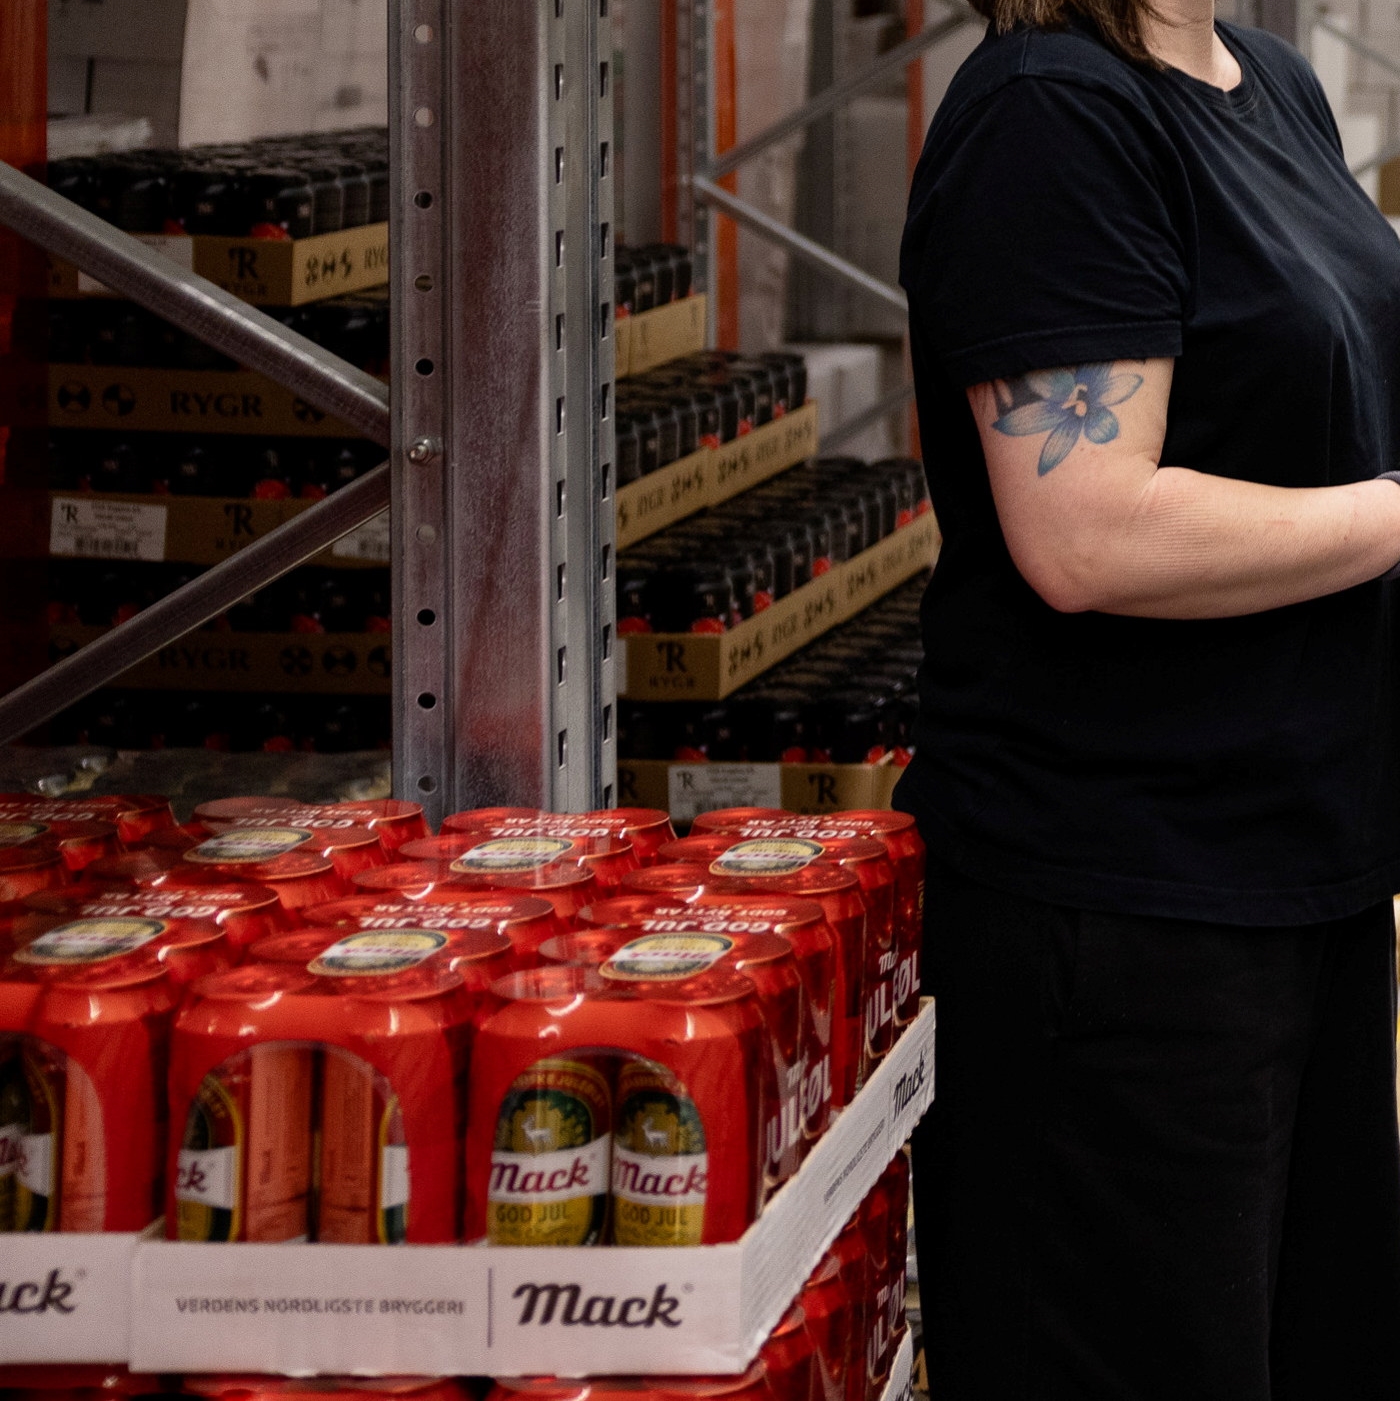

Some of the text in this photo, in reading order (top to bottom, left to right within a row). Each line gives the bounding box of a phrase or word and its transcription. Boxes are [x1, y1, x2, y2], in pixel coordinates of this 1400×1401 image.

[170, 391, 262, 417] RYGR
[158, 649, 251, 672] RYGR
[641, 919, 770, 933] GOD JUL
[893, 1050, 925, 1122] Mack
[491, 1157, 589, 1193] Mack
[614, 1157, 707, 1197] Mack
[175, 1297, 466, 1315] VERDENS NORDLIGSTE BRYGGERI
[512, 1281, 683, 1328] Mack
